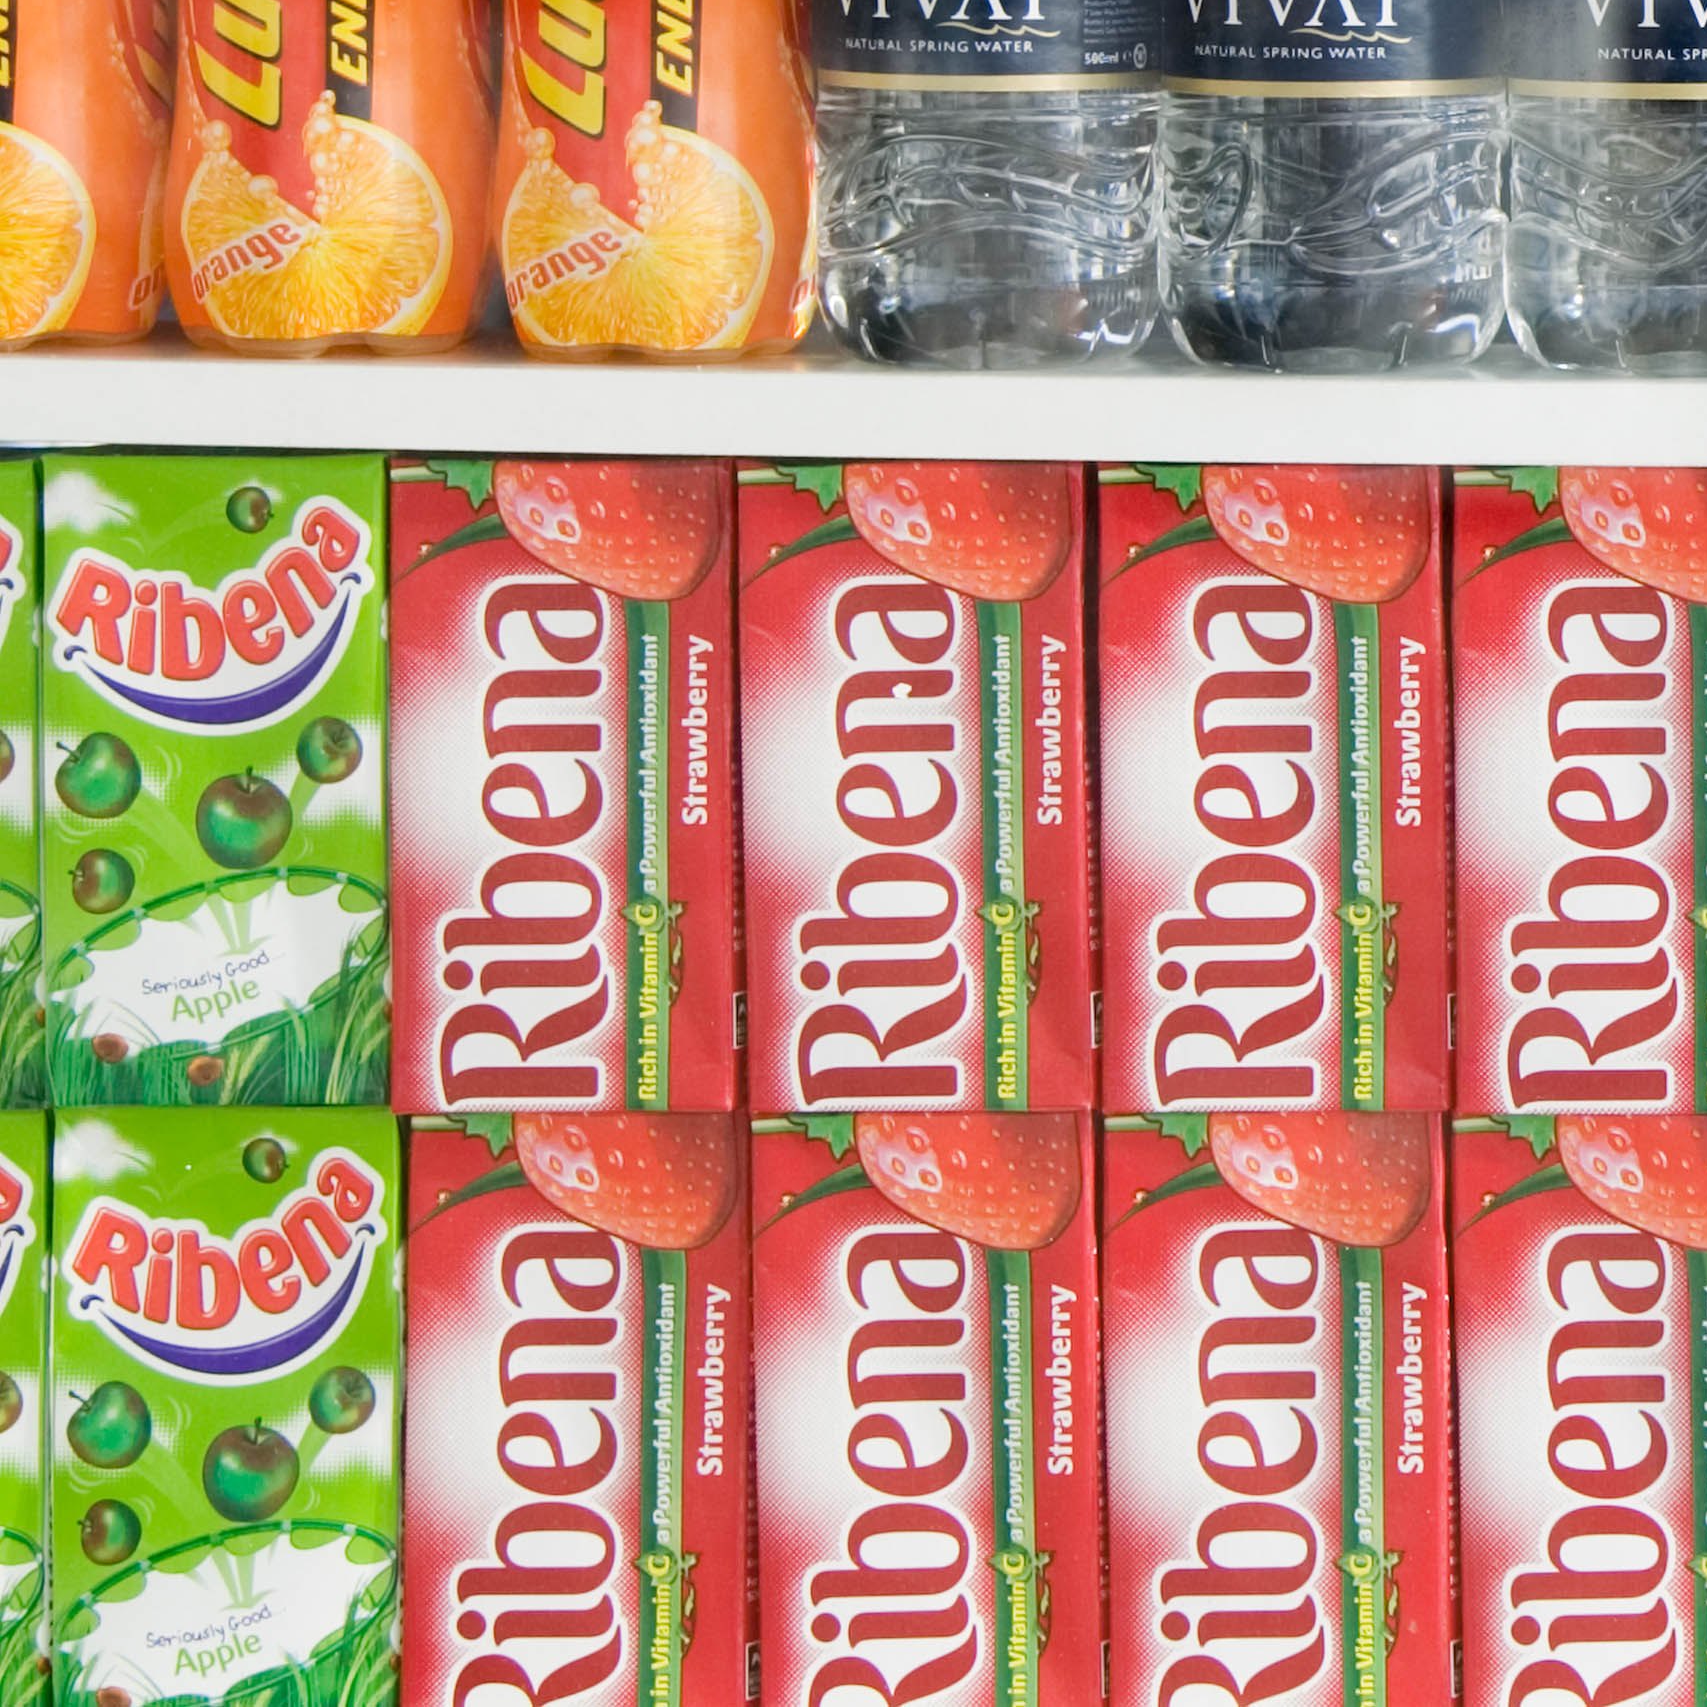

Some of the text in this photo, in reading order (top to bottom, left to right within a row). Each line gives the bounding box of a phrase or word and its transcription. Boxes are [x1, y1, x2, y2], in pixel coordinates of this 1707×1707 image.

[1597, 48, 1675, 61] NATURAL
[682, 635, 715, 825] Strawberry
[441, 583, 611, 1105] Ribena
[636, 635, 658, 1099] Rich in Vitamin C a Powerful Antioxidant
[1507, 586, 1677, 1108] Ribena
[73, 1157, 374, 1329] Ribena
[147, 1625, 226, 1648] Seriously
[174, 1633, 263, 1677] Apple
